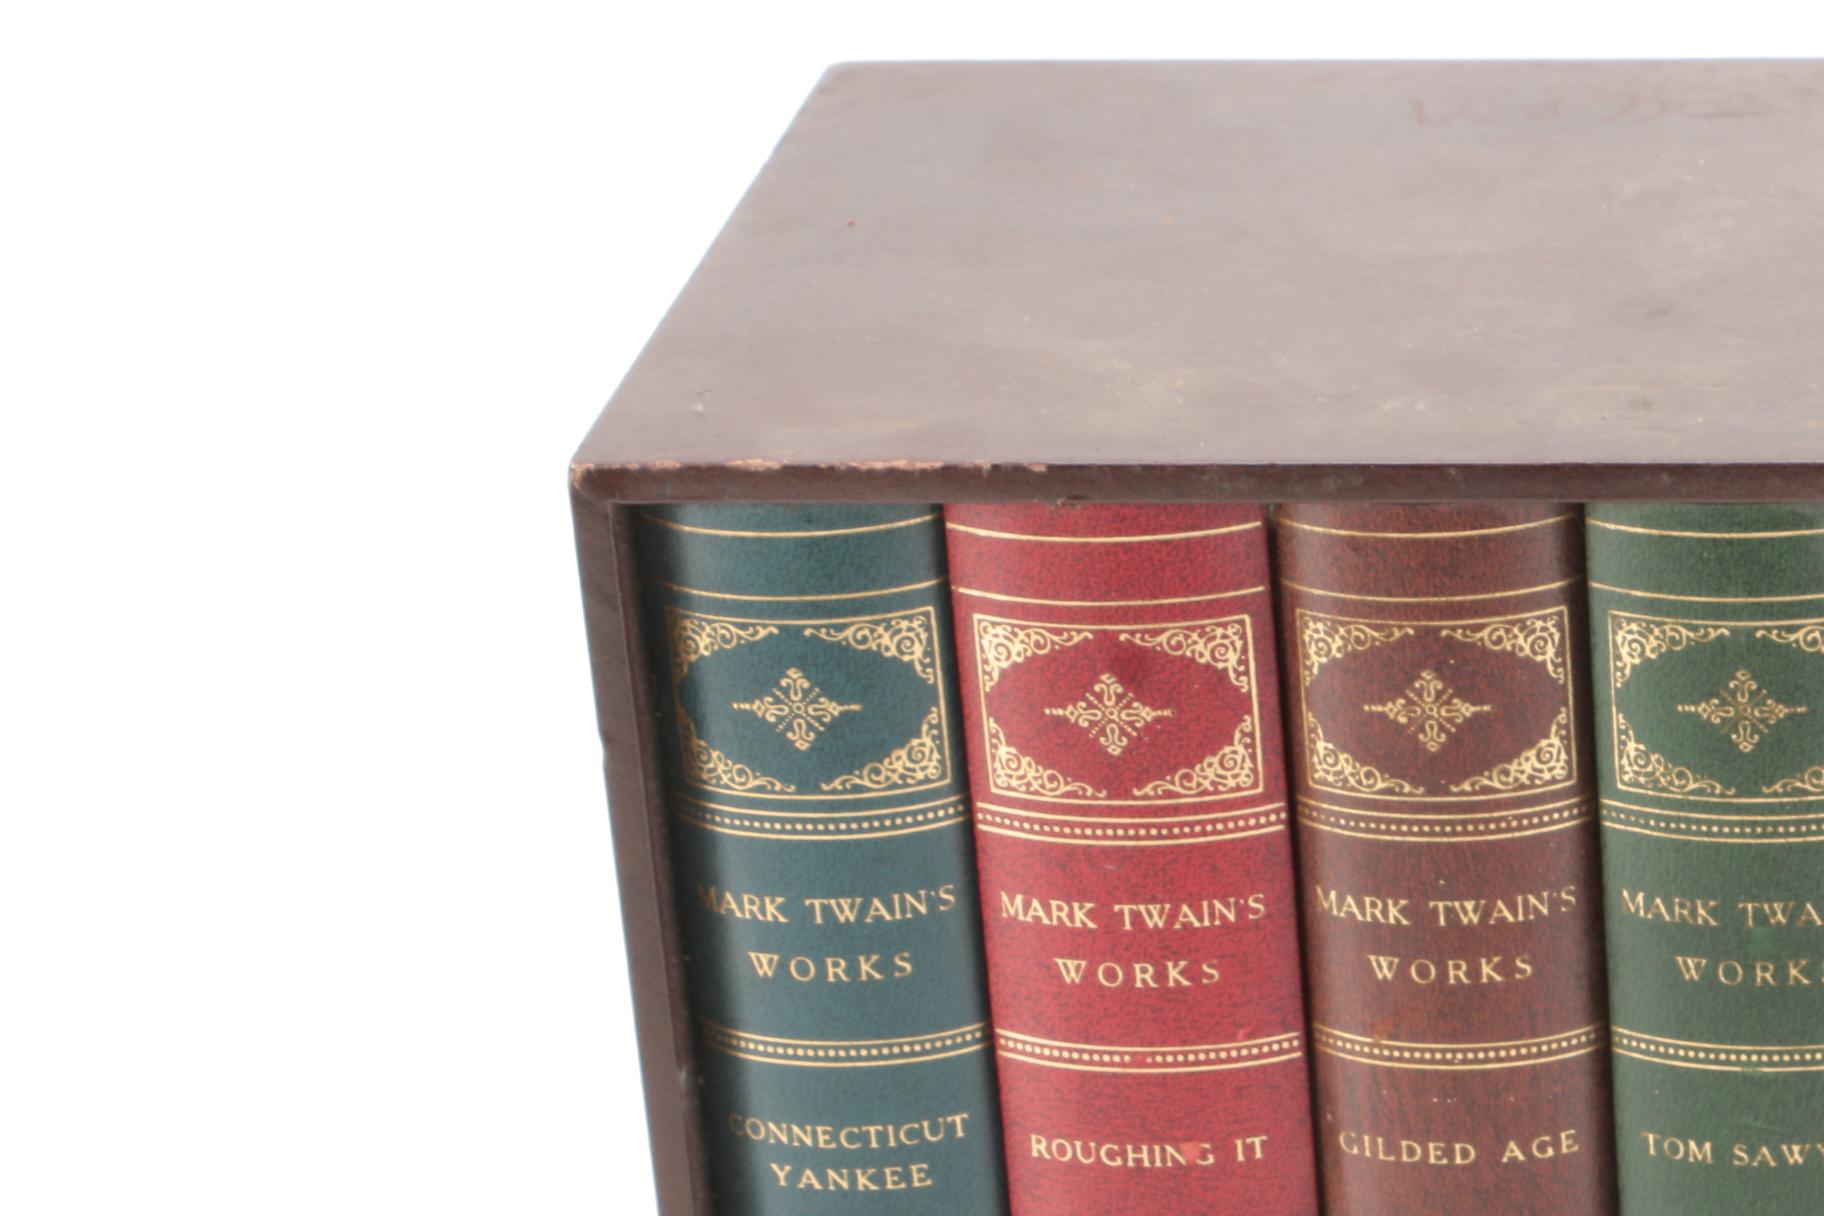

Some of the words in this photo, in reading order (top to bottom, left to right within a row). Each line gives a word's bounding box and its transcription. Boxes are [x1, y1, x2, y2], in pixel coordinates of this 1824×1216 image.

[804, 884, 957, 925] TWAIN'S
[1001, 891, 1098, 929] MARK
[1114, 894, 1267, 931] TWAIN'S
[1316, 887, 1411, 926] MARK
[1429, 886, 1578, 927] TWAIN'S
[1621, 889, 1721, 927] MARK
[747, 950, 913, 983] WORKS
[1055, 957, 1220, 989] WORKS
[1368, 954, 1533, 985] WORKS
[727, 1112, 970, 1151] CONNECTICUT
[1235, 1136, 1268, 1162] IT
[1339, 1131, 1476, 1165] GILDED
[1501, 1129, 1580, 1163] AGE
[1641, 1131, 1713, 1165] TOM
[770, 1163, 933, 1191] YANKEE
